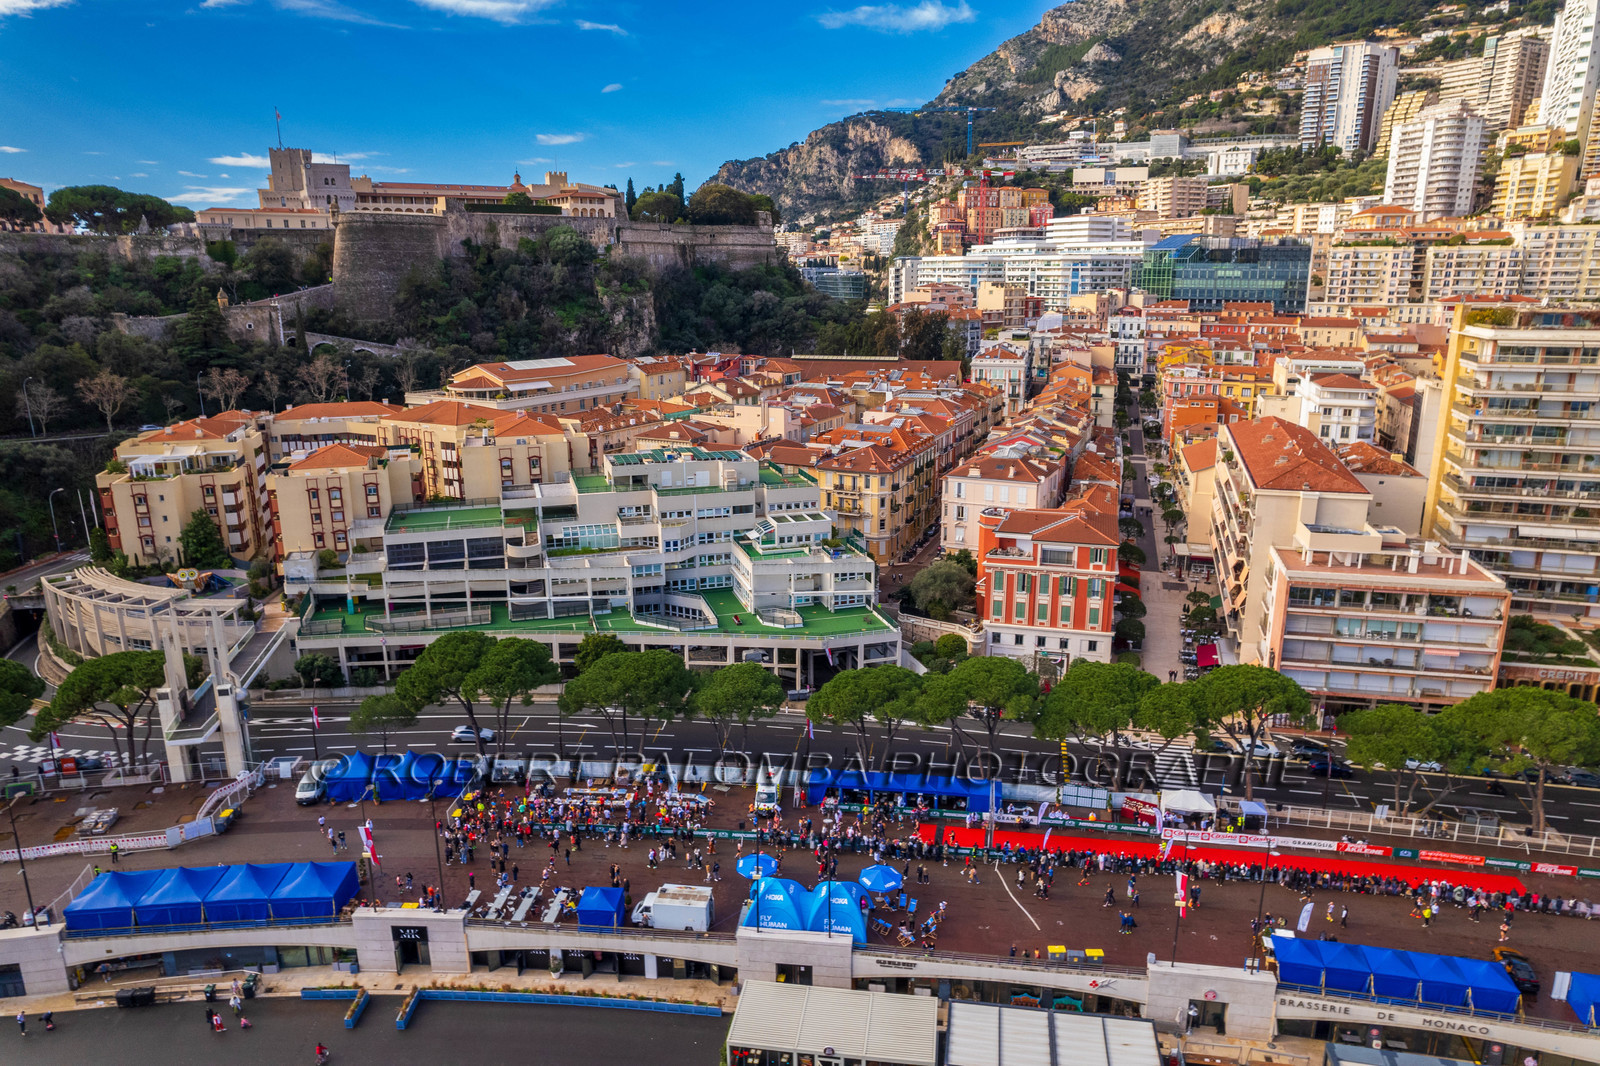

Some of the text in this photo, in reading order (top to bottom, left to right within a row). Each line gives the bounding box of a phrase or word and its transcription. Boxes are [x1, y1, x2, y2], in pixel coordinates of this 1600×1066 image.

[1539, 670, 1588, 681] CREDIT
[1292, 840, 1333, 849] GRAMAGLIA
[765, 894, 784, 902] HOKA
[1279, 998, 1490, 1035] BRASSERIE DE MONACO
